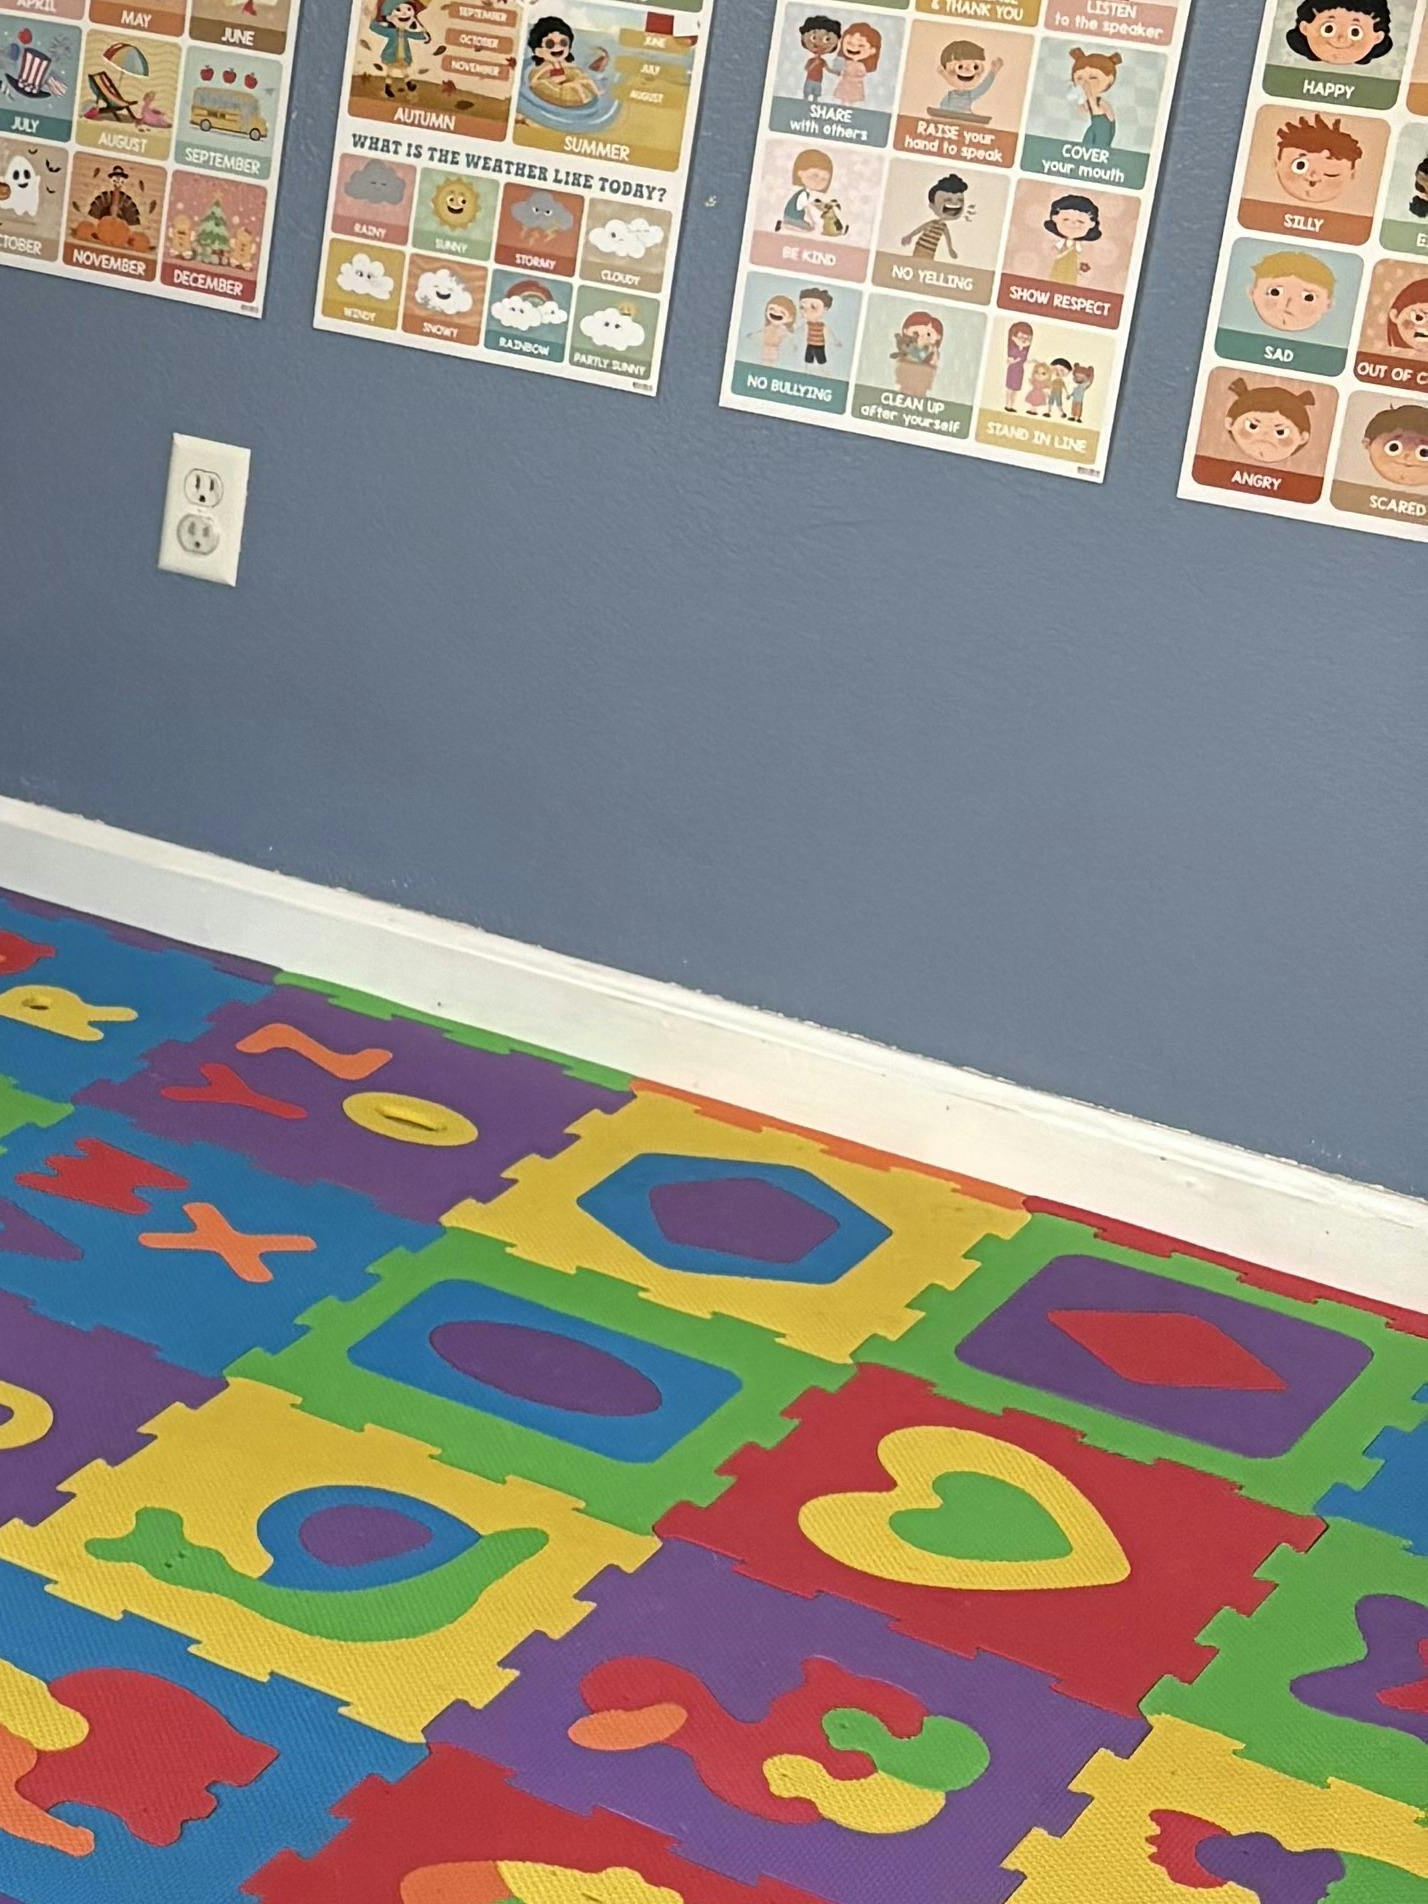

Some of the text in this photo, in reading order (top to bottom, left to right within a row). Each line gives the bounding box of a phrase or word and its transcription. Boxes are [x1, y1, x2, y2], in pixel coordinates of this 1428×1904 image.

[121, 9, 152, 28] MAY
[995, 5, 1024, 22] YOU
[1087, 0, 1136, 18] LISTEN
[221, 26, 255, 46] JUNE
[1055, 12, 1164, 41] to the speaker
[1303, 78, 1355, 101] HAPPY
[10, 116, 39, 133] JULY
[394, 107, 456, 131] AUTUMN
[810, 105, 853, 123] SHARE
[790, 120, 868, 141] with others
[917, 121, 996, 146] RAISE your
[98, 132, 148, 153] AUGUST
[563, 135, 630, 161] SUMMER
[904, 135, 1004, 164] hand to speak
[185, 147, 260, 175] SEPTEMBER
[1062, 144, 1110, 164] COVER
[352, 133, 668, 204] WHAT IS THE WEATHER LIKE TODAY?
[1042, 158, 1125, 183] your mouth
[1283, 213, 1324, 233] SILLY
[73, 248, 146, 276] NOVEMBER
[515, 253, 556, 272] STORMY
[782, 246, 836, 267] BE KIND
[173, 269, 243, 296] DECEMBER
[600, 270, 641, 286] CLOUDY
[892, 264, 973, 291] NO YELLING
[1008, 285, 1111, 317] SHOW RESPECT
[1264, 345, 1294, 362] SAD
[1357, 362, 1413, 383] OUT OF
[747, 375, 832, 403] NO BULLYING
[881, 392, 945, 413] CLEAN UP
[861, 404, 961, 434] after yourself
[987, 420, 1087, 452] STAND IN LINE
[1231, 470, 1281, 491] ANGRY
[1369, 495, 1427, 517] SCARED
